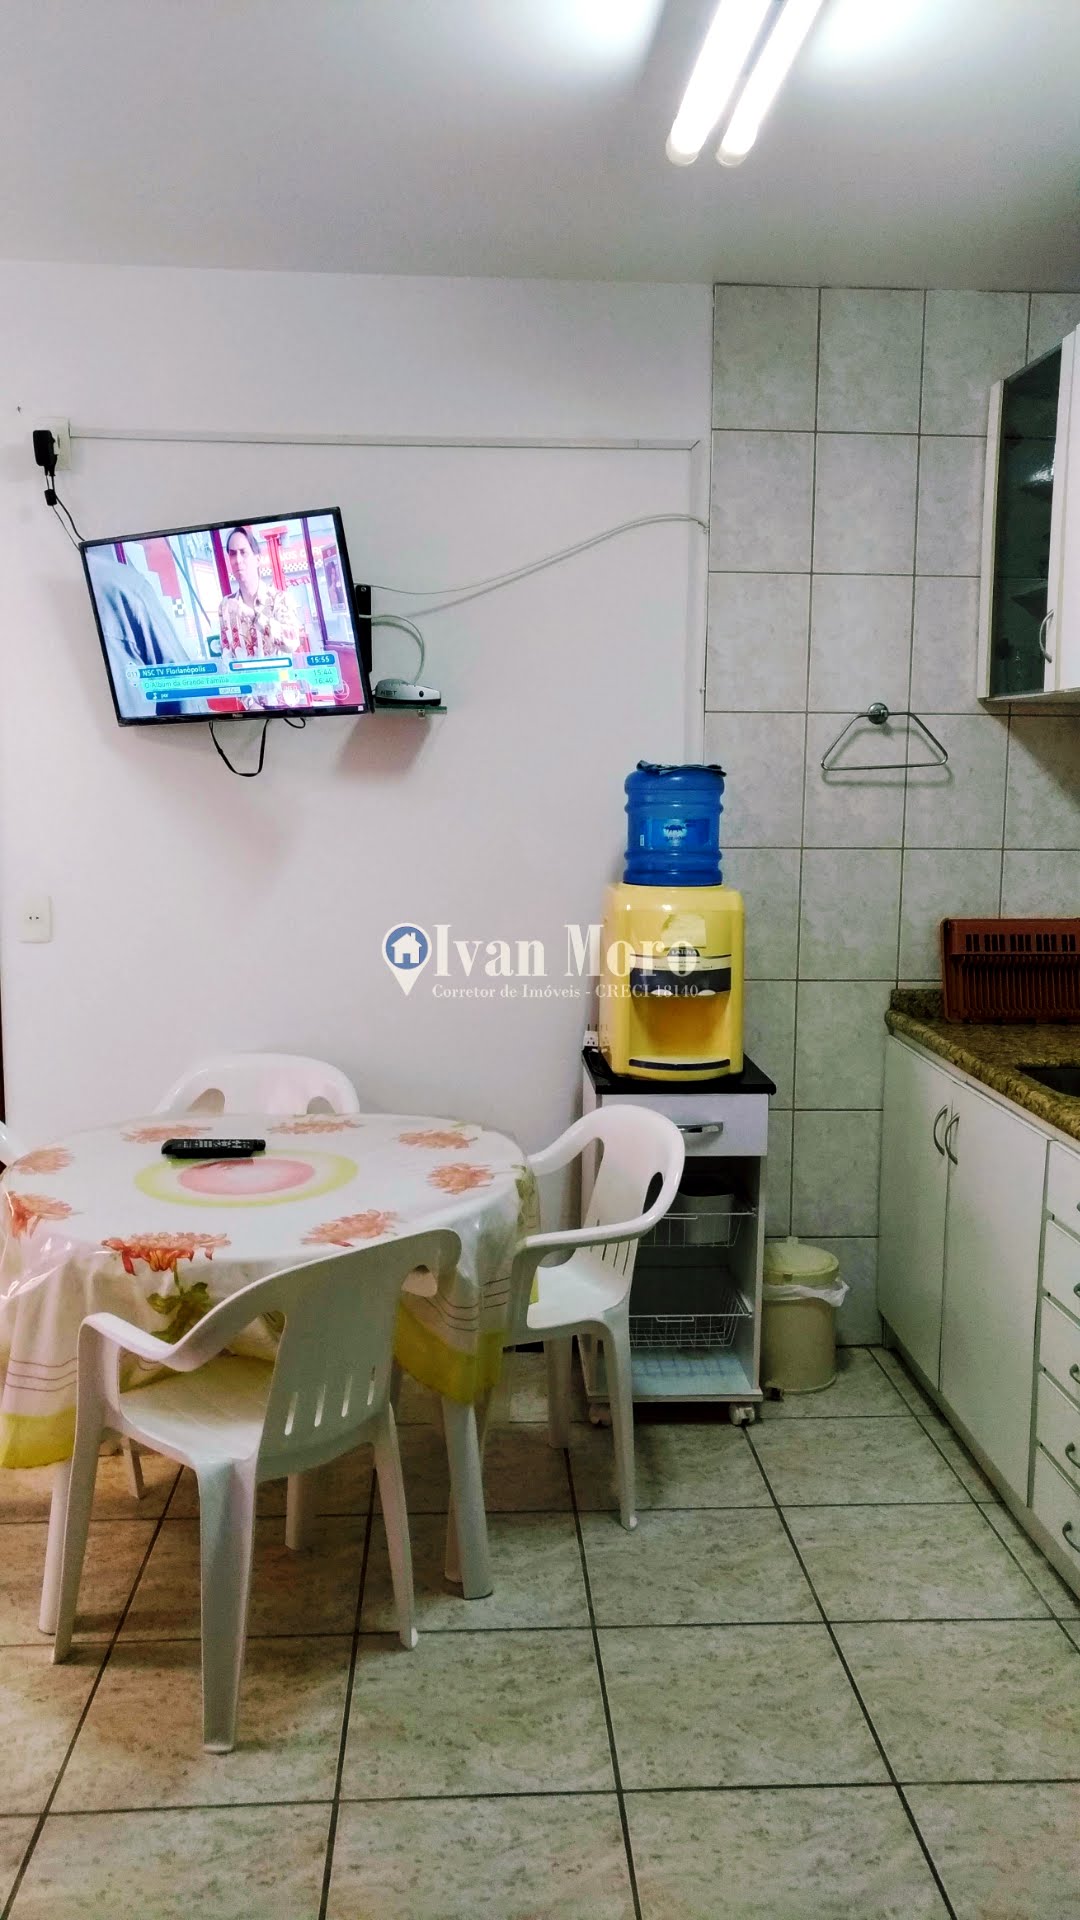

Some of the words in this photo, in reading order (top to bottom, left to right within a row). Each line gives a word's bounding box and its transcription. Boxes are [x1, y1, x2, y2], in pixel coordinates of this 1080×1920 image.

[310, 656, 330, 664] 15:55
[142, 669, 155, 677] NSC
[156, 668, 164, 676] TV
